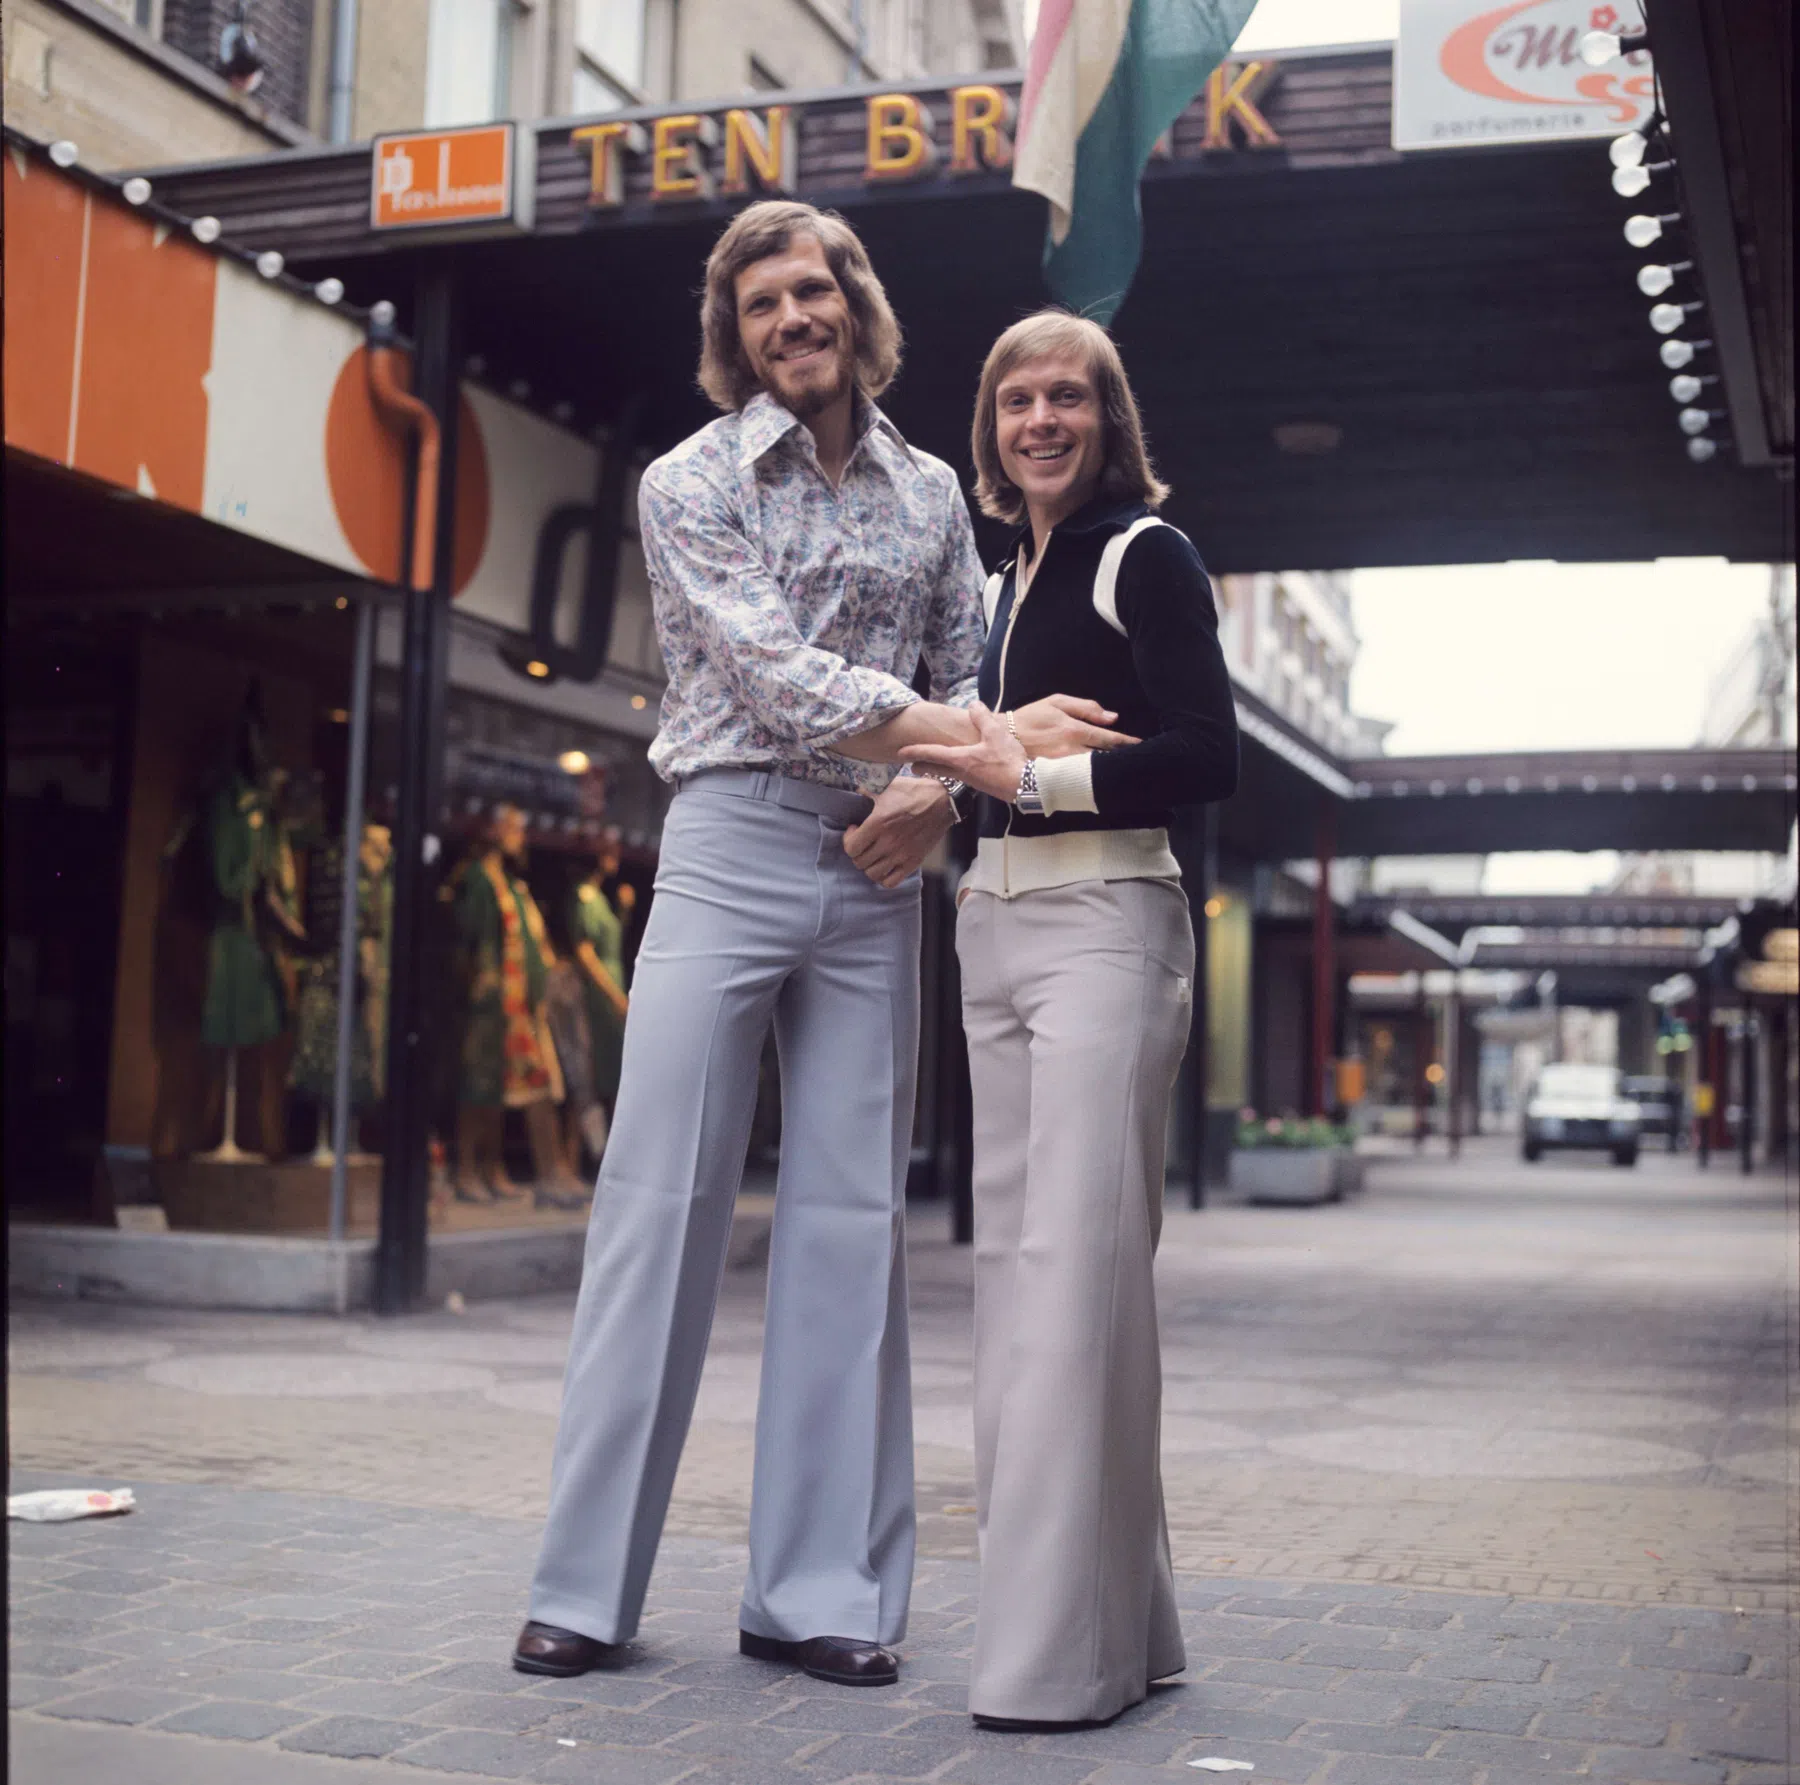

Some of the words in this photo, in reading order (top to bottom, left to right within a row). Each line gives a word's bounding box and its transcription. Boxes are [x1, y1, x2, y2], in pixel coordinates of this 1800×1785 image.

[569, 105, 796, 206] TEN
[862, 57, 1281, 181] BRK
[1431, 112, 1585, 138] parfumerie
